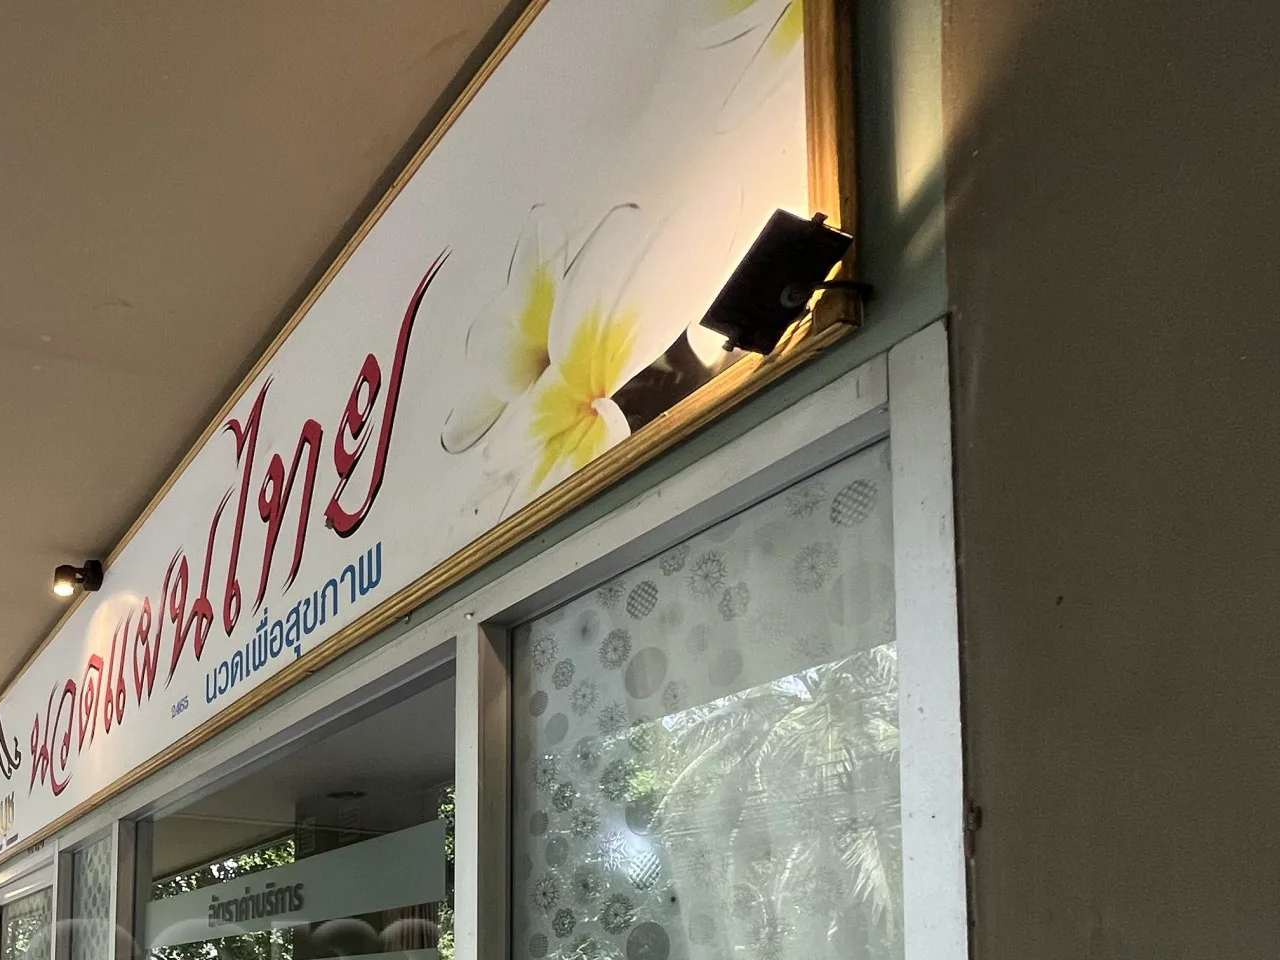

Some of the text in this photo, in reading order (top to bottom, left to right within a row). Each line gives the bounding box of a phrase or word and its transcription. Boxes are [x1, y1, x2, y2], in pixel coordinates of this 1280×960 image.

[28, 246, 452, 796] นวดแผนไทย
[205, 541, 383, 705] นวดเพื่อสุขภาพ
[208, 881, 305, 928] อัตราค่าบริการ
